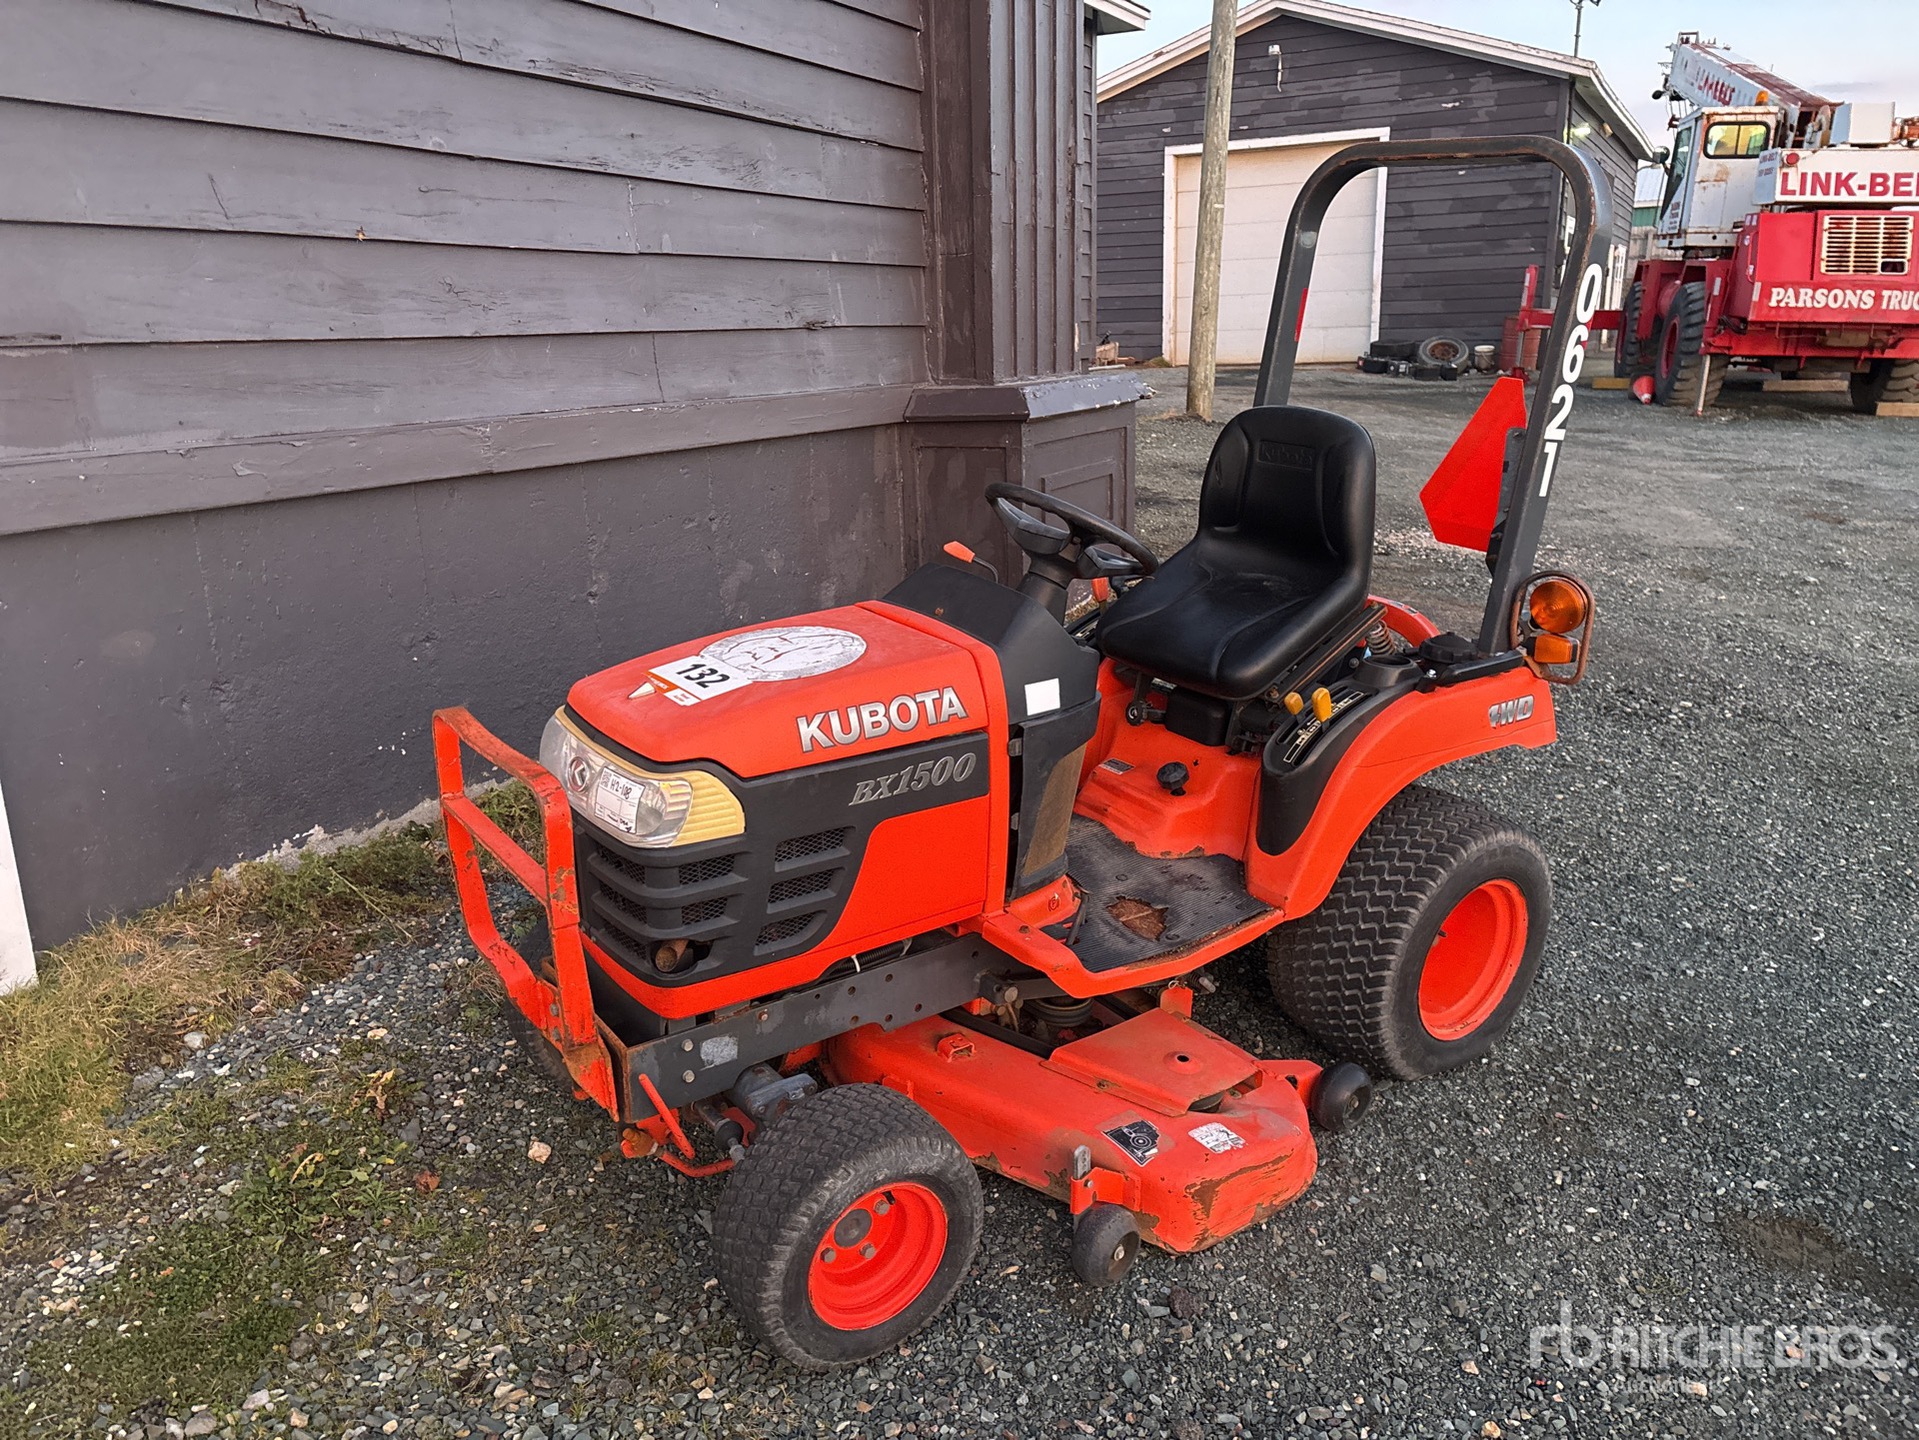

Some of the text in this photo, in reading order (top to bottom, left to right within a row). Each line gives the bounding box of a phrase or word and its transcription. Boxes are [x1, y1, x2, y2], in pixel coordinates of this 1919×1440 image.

[1780, 171, 1919, 197] LINK-BE
[1768, 287, 1875, 309] PARSONS
[1538, 263, 1603, 497] 0621
[676, 663, 731, 689] 132
[796, 686, 969, 753] KUBOTA
[848, 752, 976, 806] BX1500
